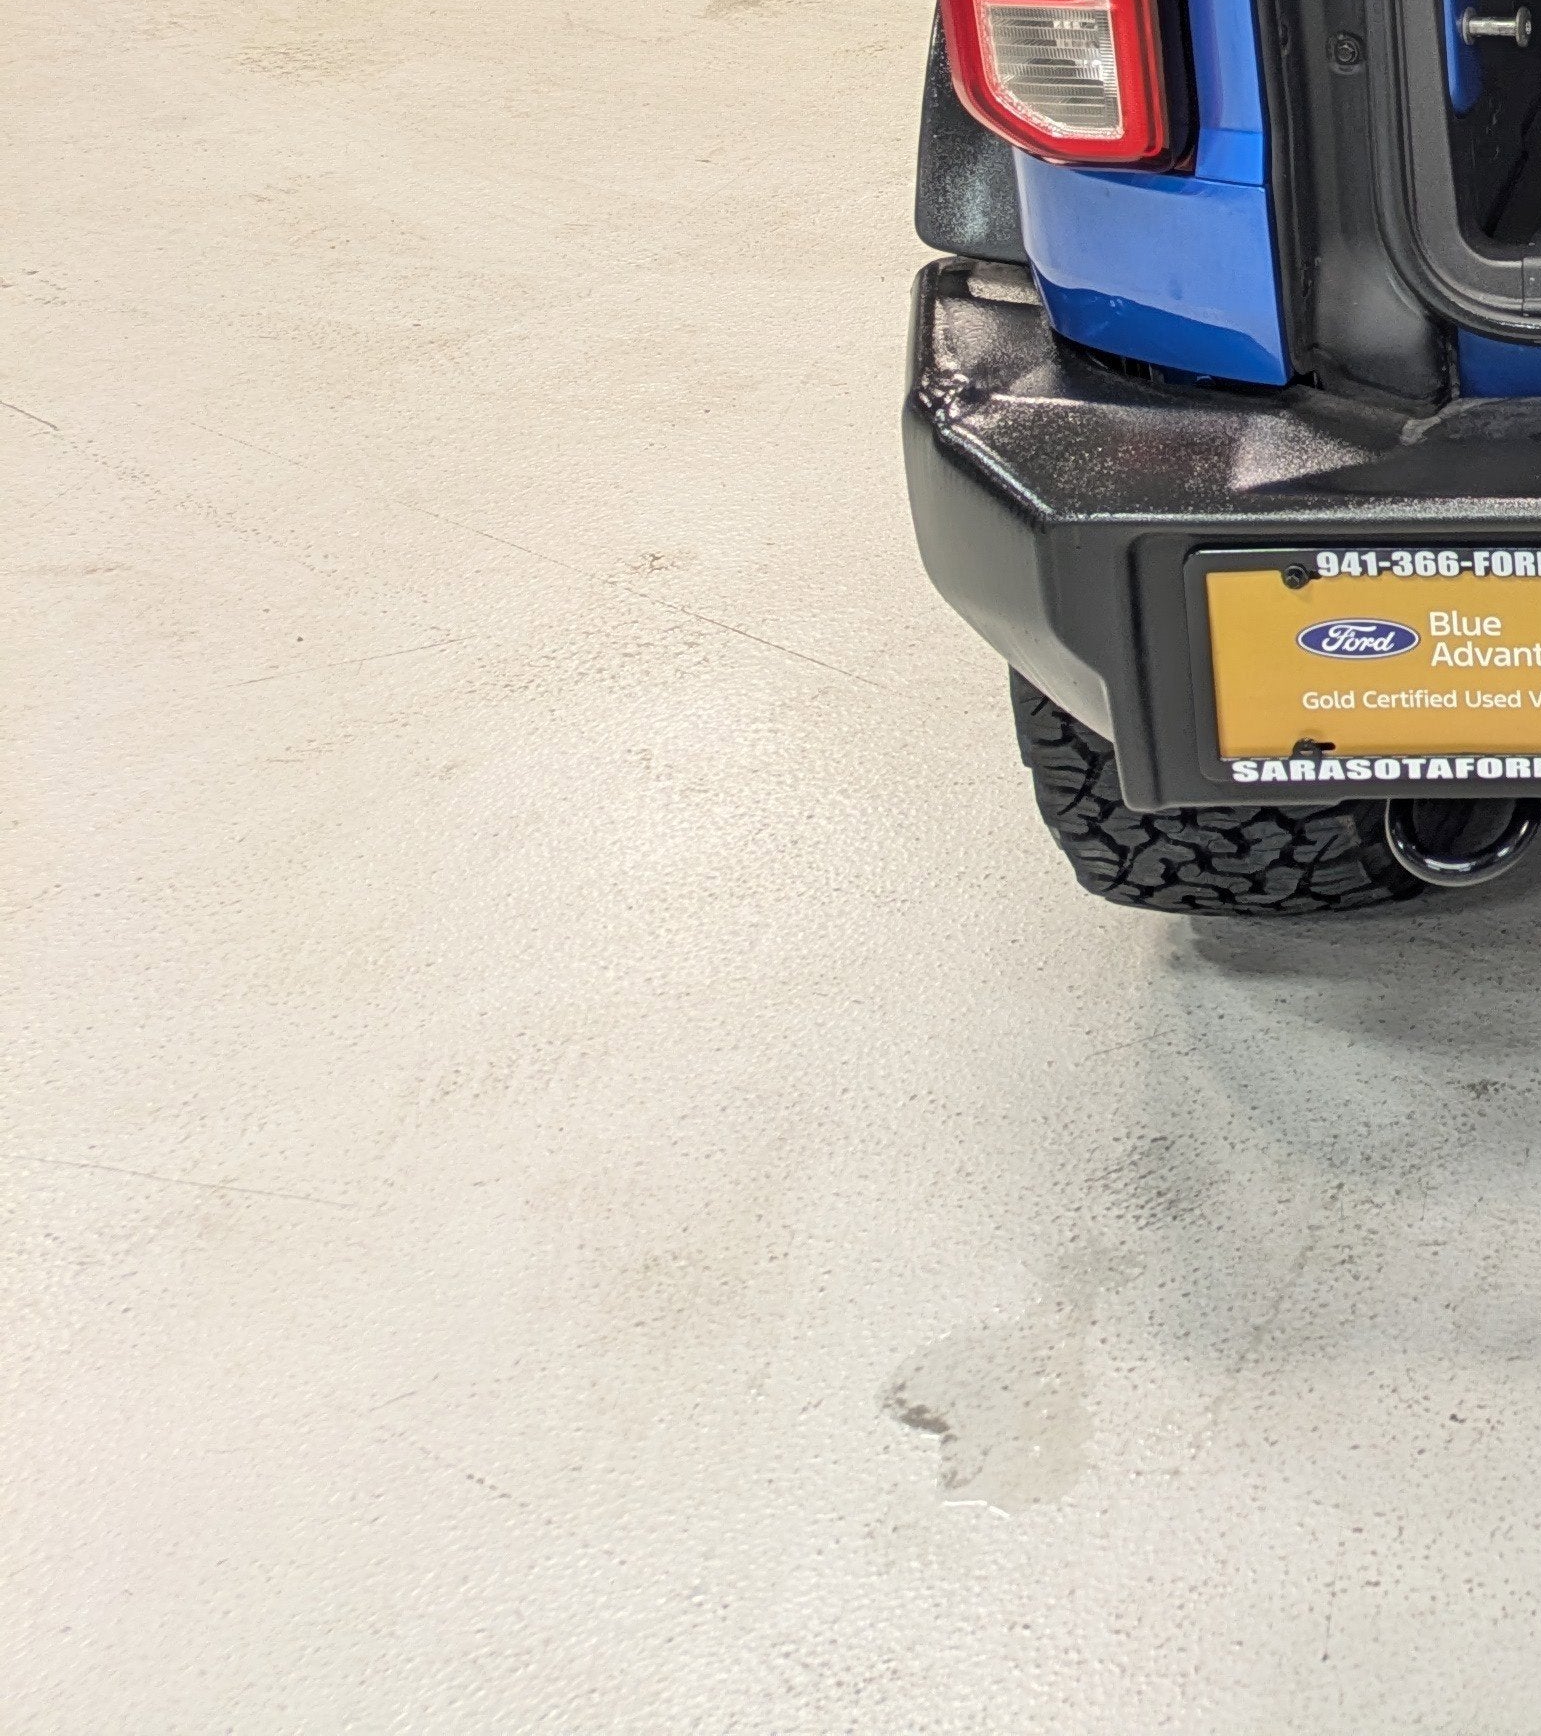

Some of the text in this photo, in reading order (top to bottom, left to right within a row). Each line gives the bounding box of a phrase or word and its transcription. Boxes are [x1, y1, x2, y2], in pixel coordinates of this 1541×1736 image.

[1430, 610, 1502, 637] Blue
[1321, 624, 1396, 652] Ford
[1302, 690, 1355, 710] Gold
[1363, 689, 1458, 709] Certified
[1465, 689, 1522, 709] Used
